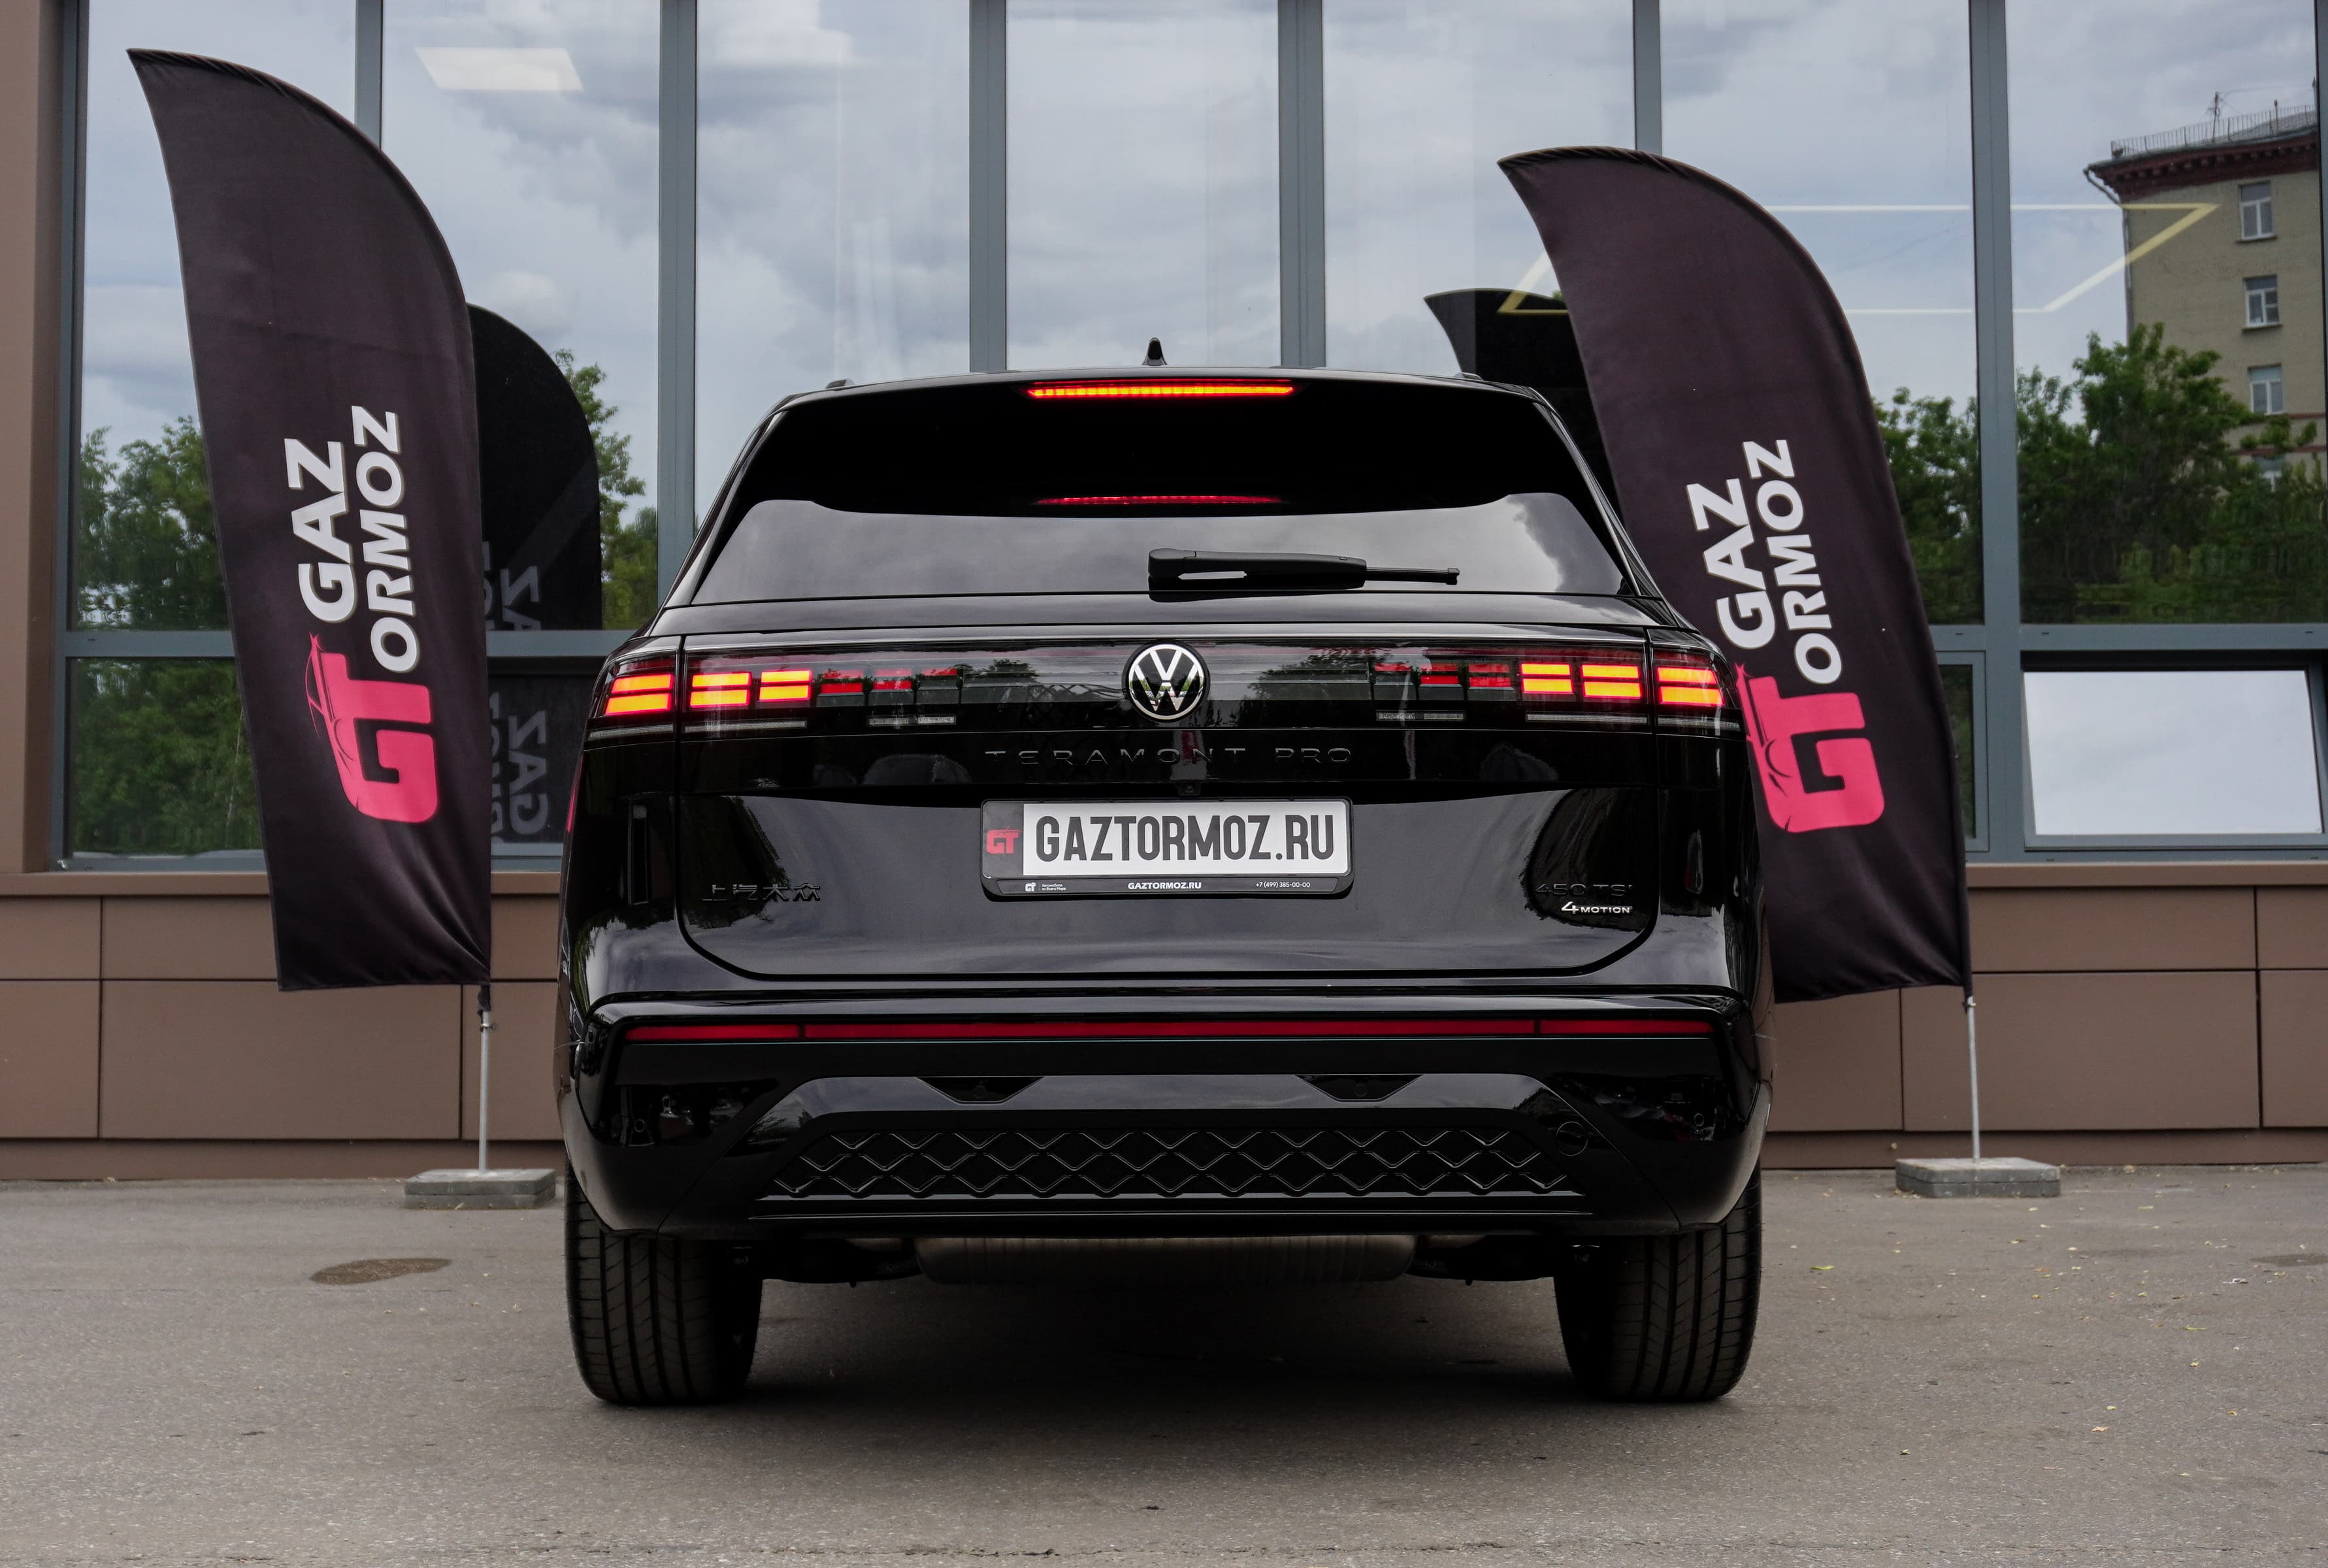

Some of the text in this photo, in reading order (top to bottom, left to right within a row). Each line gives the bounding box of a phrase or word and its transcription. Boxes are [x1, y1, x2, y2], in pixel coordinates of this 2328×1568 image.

[284, 438, 356, 623] GAZ
[351, 405, 419, 672] ORMOZ
[1686, 478, 1776, 649] GAZ
[1743, 439, 1843, 684] ORMOZ
[984, 747, 1352, 765] TERAMONT PRO
[1036, 815, 1334, 862] GAZTORMOZ.RU
[702, 883, 821, 902] 上汽大众
